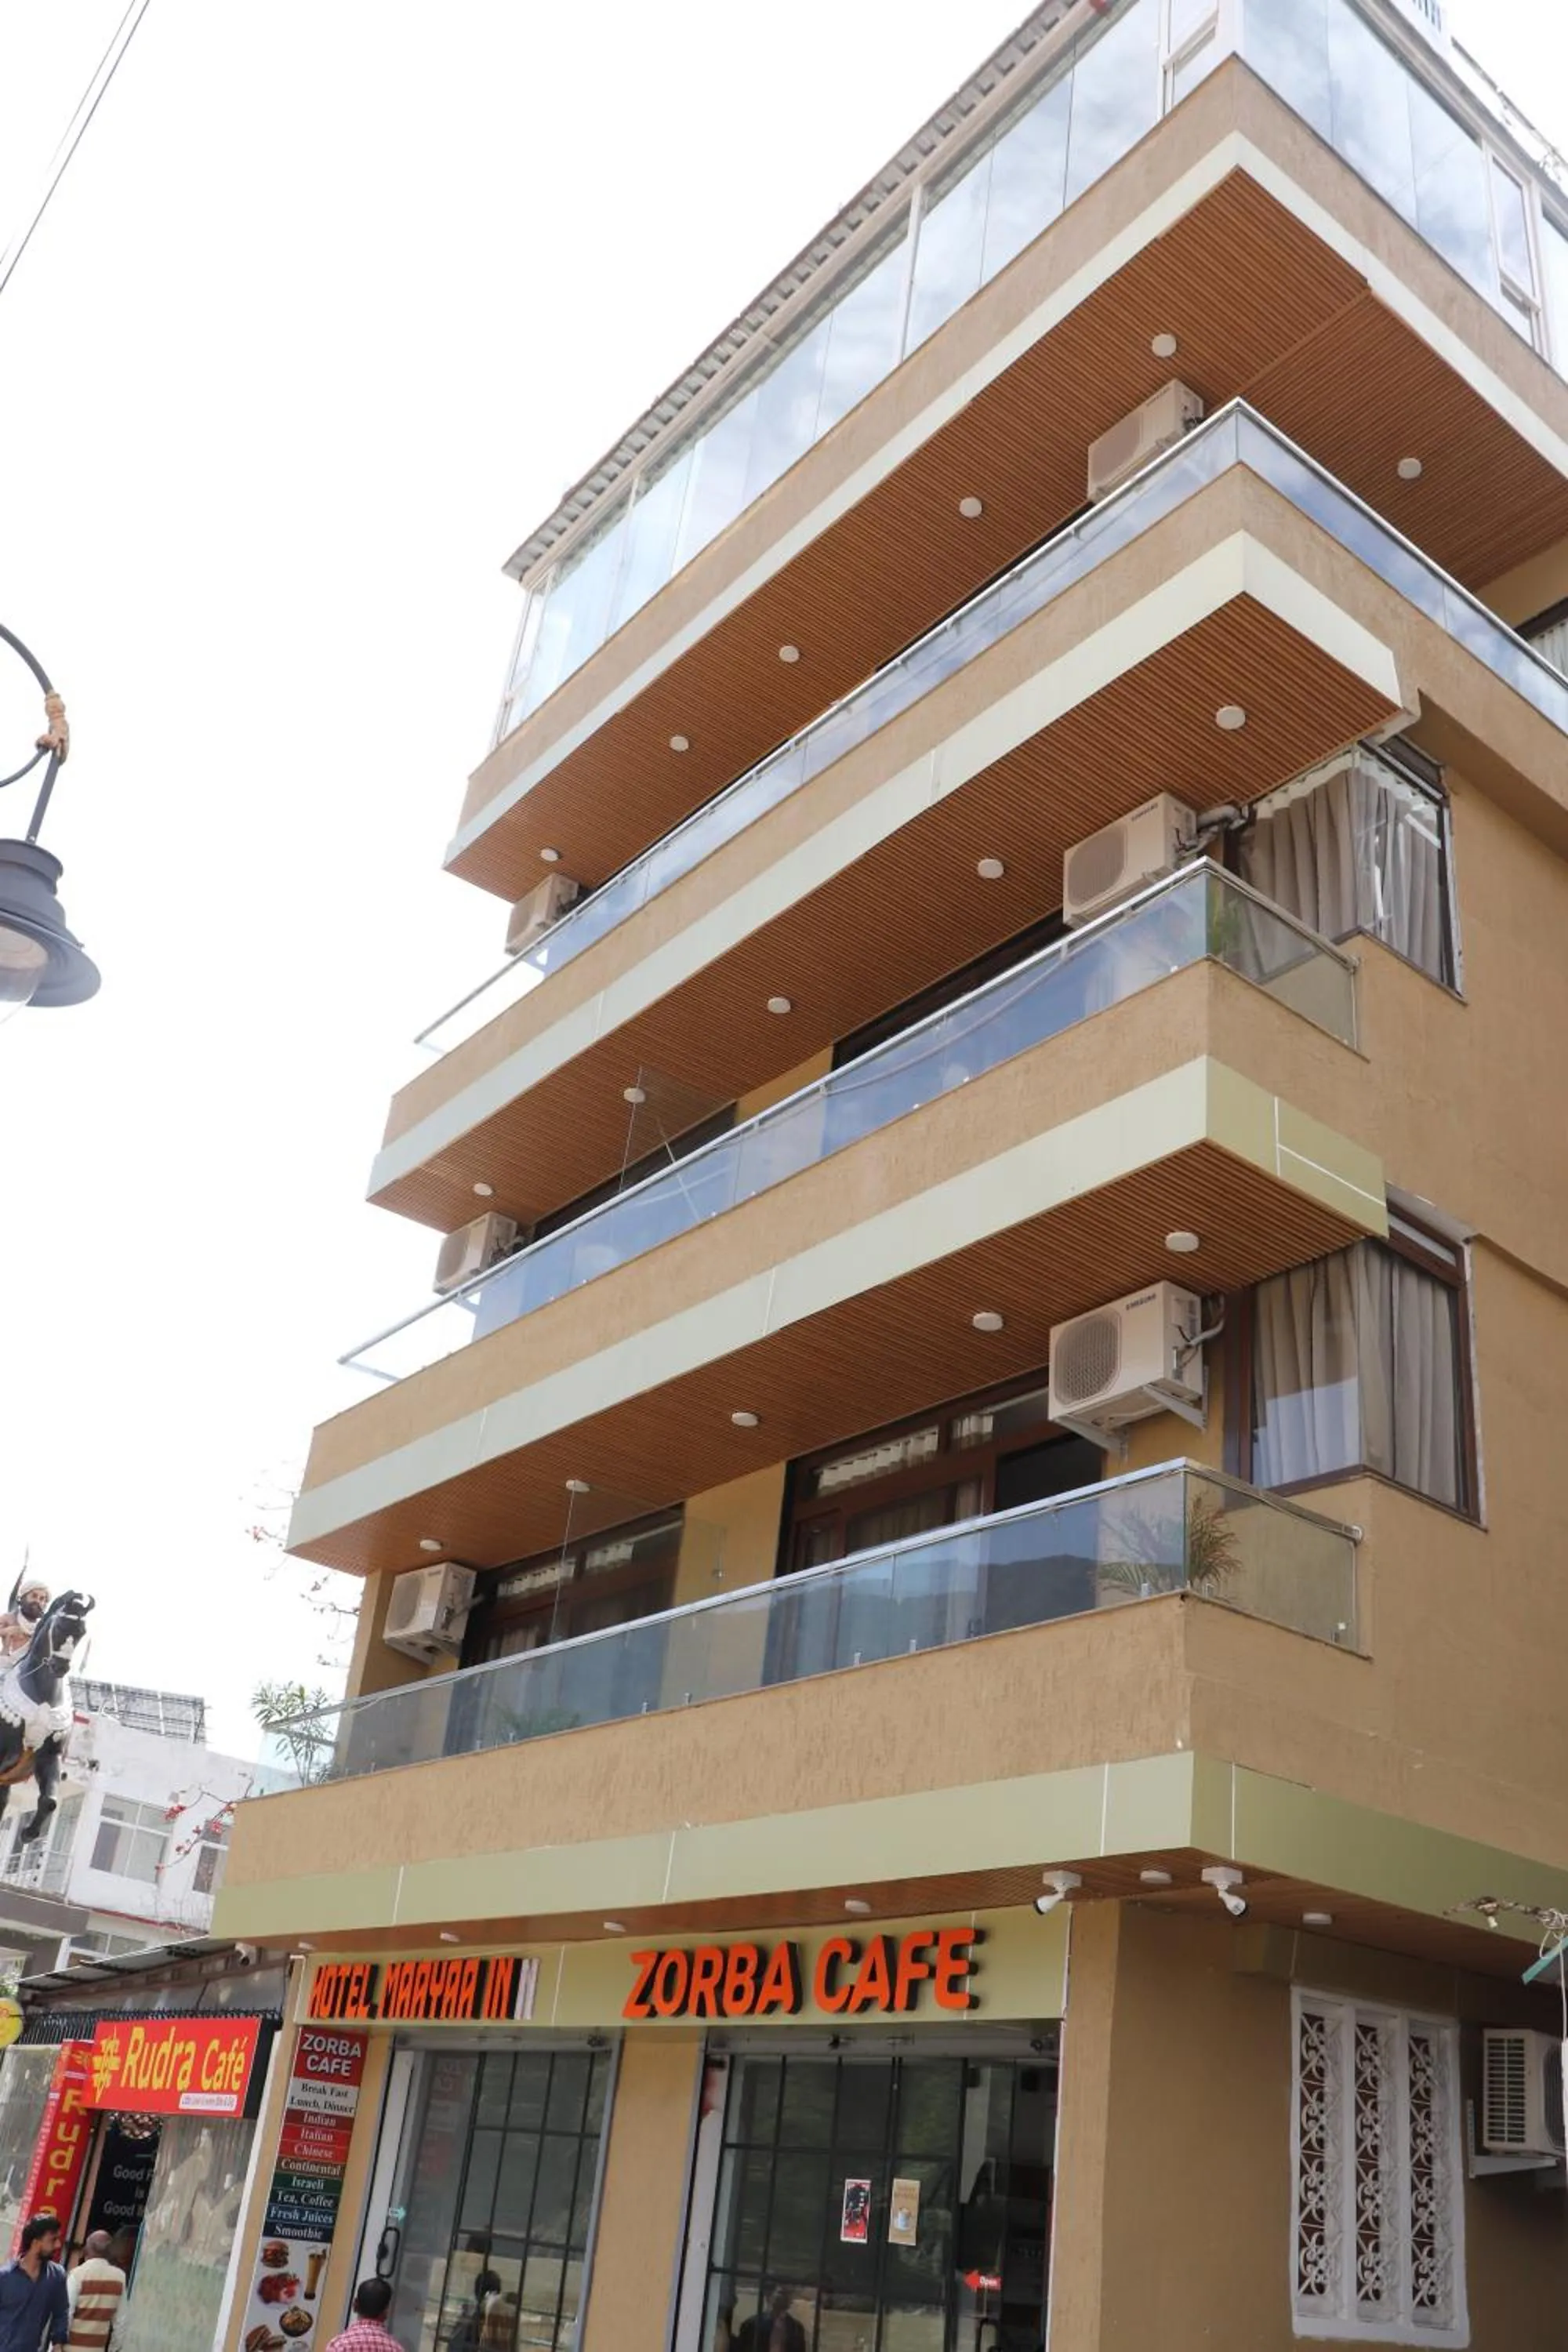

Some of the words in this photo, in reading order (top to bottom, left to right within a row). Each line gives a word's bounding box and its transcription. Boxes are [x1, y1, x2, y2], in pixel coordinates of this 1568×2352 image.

[622, 1940, 798, 2018] ZORBA
[814, 1927, 978, 2013] CAFE
[307, 1962, 373, 2019] HOTEL
[301, 2033, 361, 2058] ZORBA
[120, 2026, 196, 2092] Rudra
[201, 2036, 249, 2091] Café
[307, 2054, 352, 2077] CAFE
[301, 2082, 327, 2096] Break
[330, 2087, 349, 2098] Fast
[290, 2096, 321, 2109] Lunch,
[324, 2100, 355, 2114] Dinner
[303, 2112, 336, 2127] Indian
[300, 2127, 333, 2142] Italian
[294, 2143, 333, 2158] Chinese
[113, 2164, 144, 2182] Good
[281, 2158, 341, 2176] Continental
[291, 2176, 325, 2190] Israeli
[103, 2200, 135, 2217] Good
[301, 2192, 334, 2208] Coffee
[270, 2206, 299, 2221] Fresh
[301, 2209, 333, 2223] Juices
[274, 2222, 324, 2239] Smoothie
